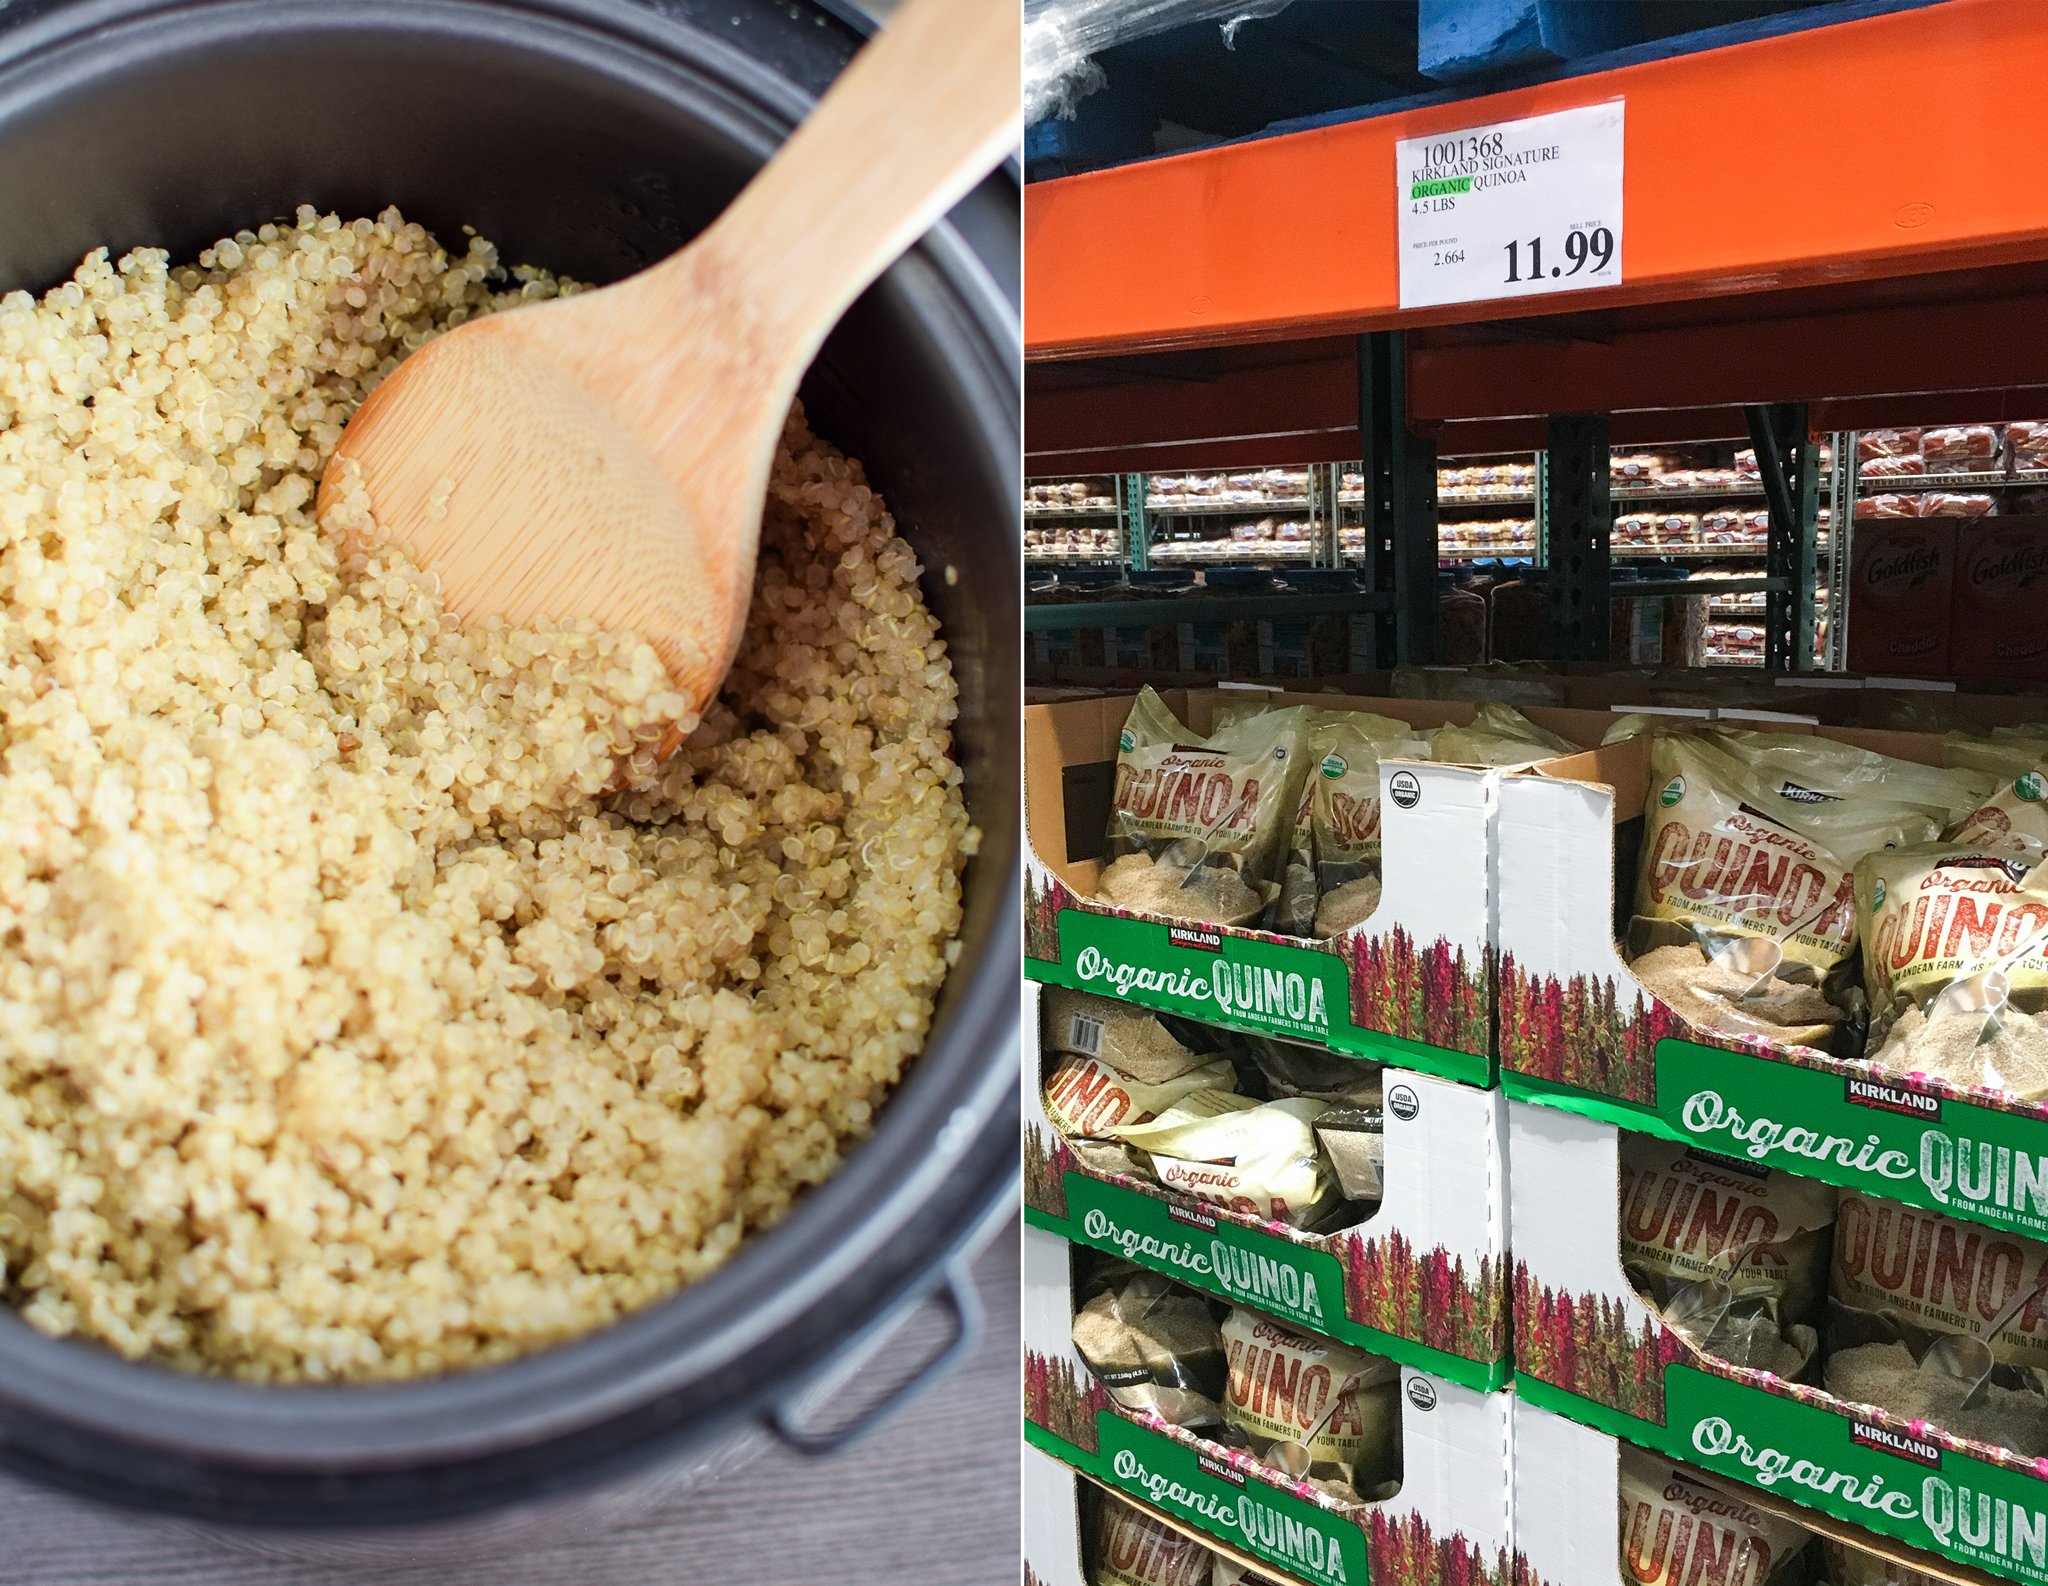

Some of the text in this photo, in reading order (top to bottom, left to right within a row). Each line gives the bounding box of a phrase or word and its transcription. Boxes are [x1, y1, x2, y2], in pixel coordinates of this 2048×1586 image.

[1411, 145, 1560, 183] KIRKLAND SIGNATURE
[1423, 132, 1504, 168] 1001368
[1411, 168, 1527, 199] ORGANIC QUINOA
[1411, 197, 1456, 215] 4.5 LBS
[1433, 249, 1465, 267] 2.664
[1503, 227, 1614, 283] 11.99
[1868, 546, 1940, 585] Goldfish
[1161, 755, 1226, 769] Organic
[1396, 780, 1414, 790] USDA
[1726, 814, 1817, 861] Organic
[1648, 821, 1856, 943] QUINOA
[1919, 870, 2028, 894] Organic
[1170, 928, 1221, 946] KIRKLAND
[1666, 895, 1690, 914] FROM
[1690, 901, 1724, 921] ANDEAN
[1766, 923, 1778, 936] TO
[1795, 931, 1818, 948] YOUR
[1819, 939, 1847, 956] TABLE
[1076, 946, 1329, 1026] Organic QUINOA
[1901, 962, 1934, 979] ANDEAN
[1233, 1009, 1329, 1036] FROM ANDEAN FARMERS TO YOUR TABLE
[1395, 1092, 1412, 1103] USDA
[1850, 1081, 1939, 1112] KIRKLAND
[1682, 1090, 2048, 1218] Organic QUIN
[1166, 1164, 1241, 1188] Organic
[1671, 1159, 1769, 1198] Organic
[1168, 1204, 1216, 1228] KIRKLAND
[1952, 1197, 1976, 1213] FROM
[1978, 1204, 2014, 1222] ANDEAN
[1084, 1208, 1323, 1318] Organic QUINOA
[1639, 1245, 1673, 1264] ANDEAN
[1674, 1255, 1715, 1275] FARMERS
[1717, 1268, 1728, 1279] TO
[1740, 1267, 1763, 1279] YOUR
[1764, 1267, 1790, 1280] TABLE
[1862, 1283, 1887, 1301] FROM
[1888, 1292, 1923, 1313] ANDEAN
[1923, 1304, 1967, 1329] FARMERS
[1968, 1320, 1981, 1334] TO
[2002, 1330, 2028, 1347] YOUR
[1227, 1339, 1364, 1436] UINOA
[1413, 1383, 1430, 1395] USDA
[1239, 1406, 1261, 1426] ANDEAN
[1261, 1417, 1292, 1437] FARMERS
[1292, 1429, 1302, 1440] TO
[1316, 1435, 1336, 1447] YOUR
[1337, 1438, 1361, 1449] TABLE
[1853, 1422, 1939, 1461] KIRKLAND
[1199, 1456, 1245, 1484] KIRKLAND
[1662, 1483, 1762, 1526] Organic
[1692, 1416, 2048, 1570] Organic QUIN
[1113, 1449, 1346, 1583] Organic QUINOA
[1953, 1541, 1977, 1557] FROM
[1978, 1550, 2013, 1570] ANDEAN
